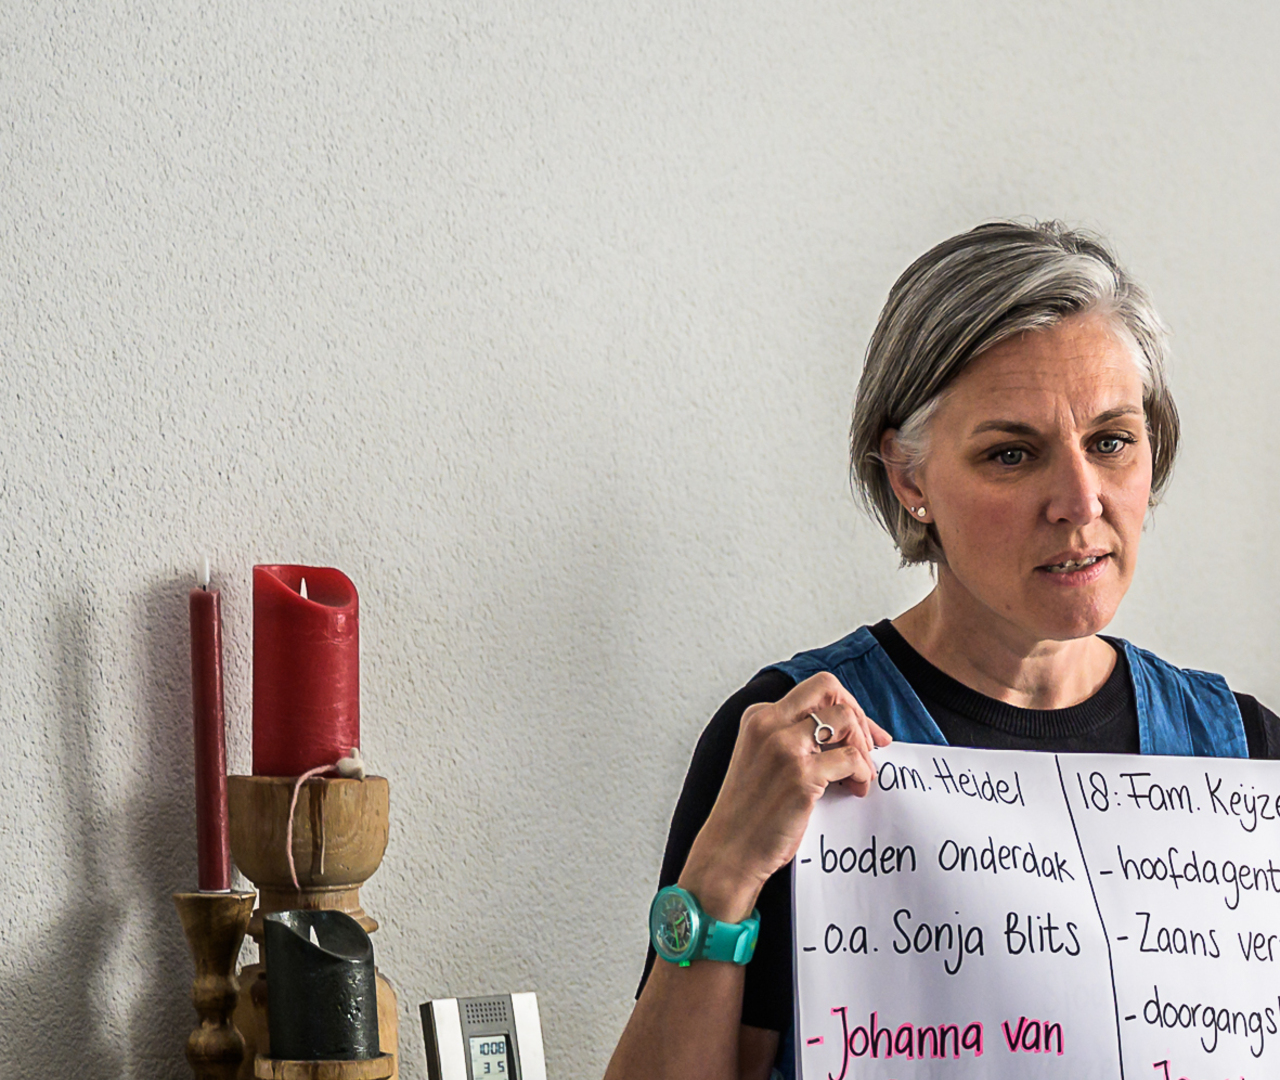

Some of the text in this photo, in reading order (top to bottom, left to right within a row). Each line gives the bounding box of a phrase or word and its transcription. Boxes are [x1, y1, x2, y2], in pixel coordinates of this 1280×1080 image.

[875, 755, 1025, 806] am. Heidel
[893, 909, 985, 976] Sonja
[1004, 912, 1081, 957] Blits
[1001, 1016, 1065, 1057] van
